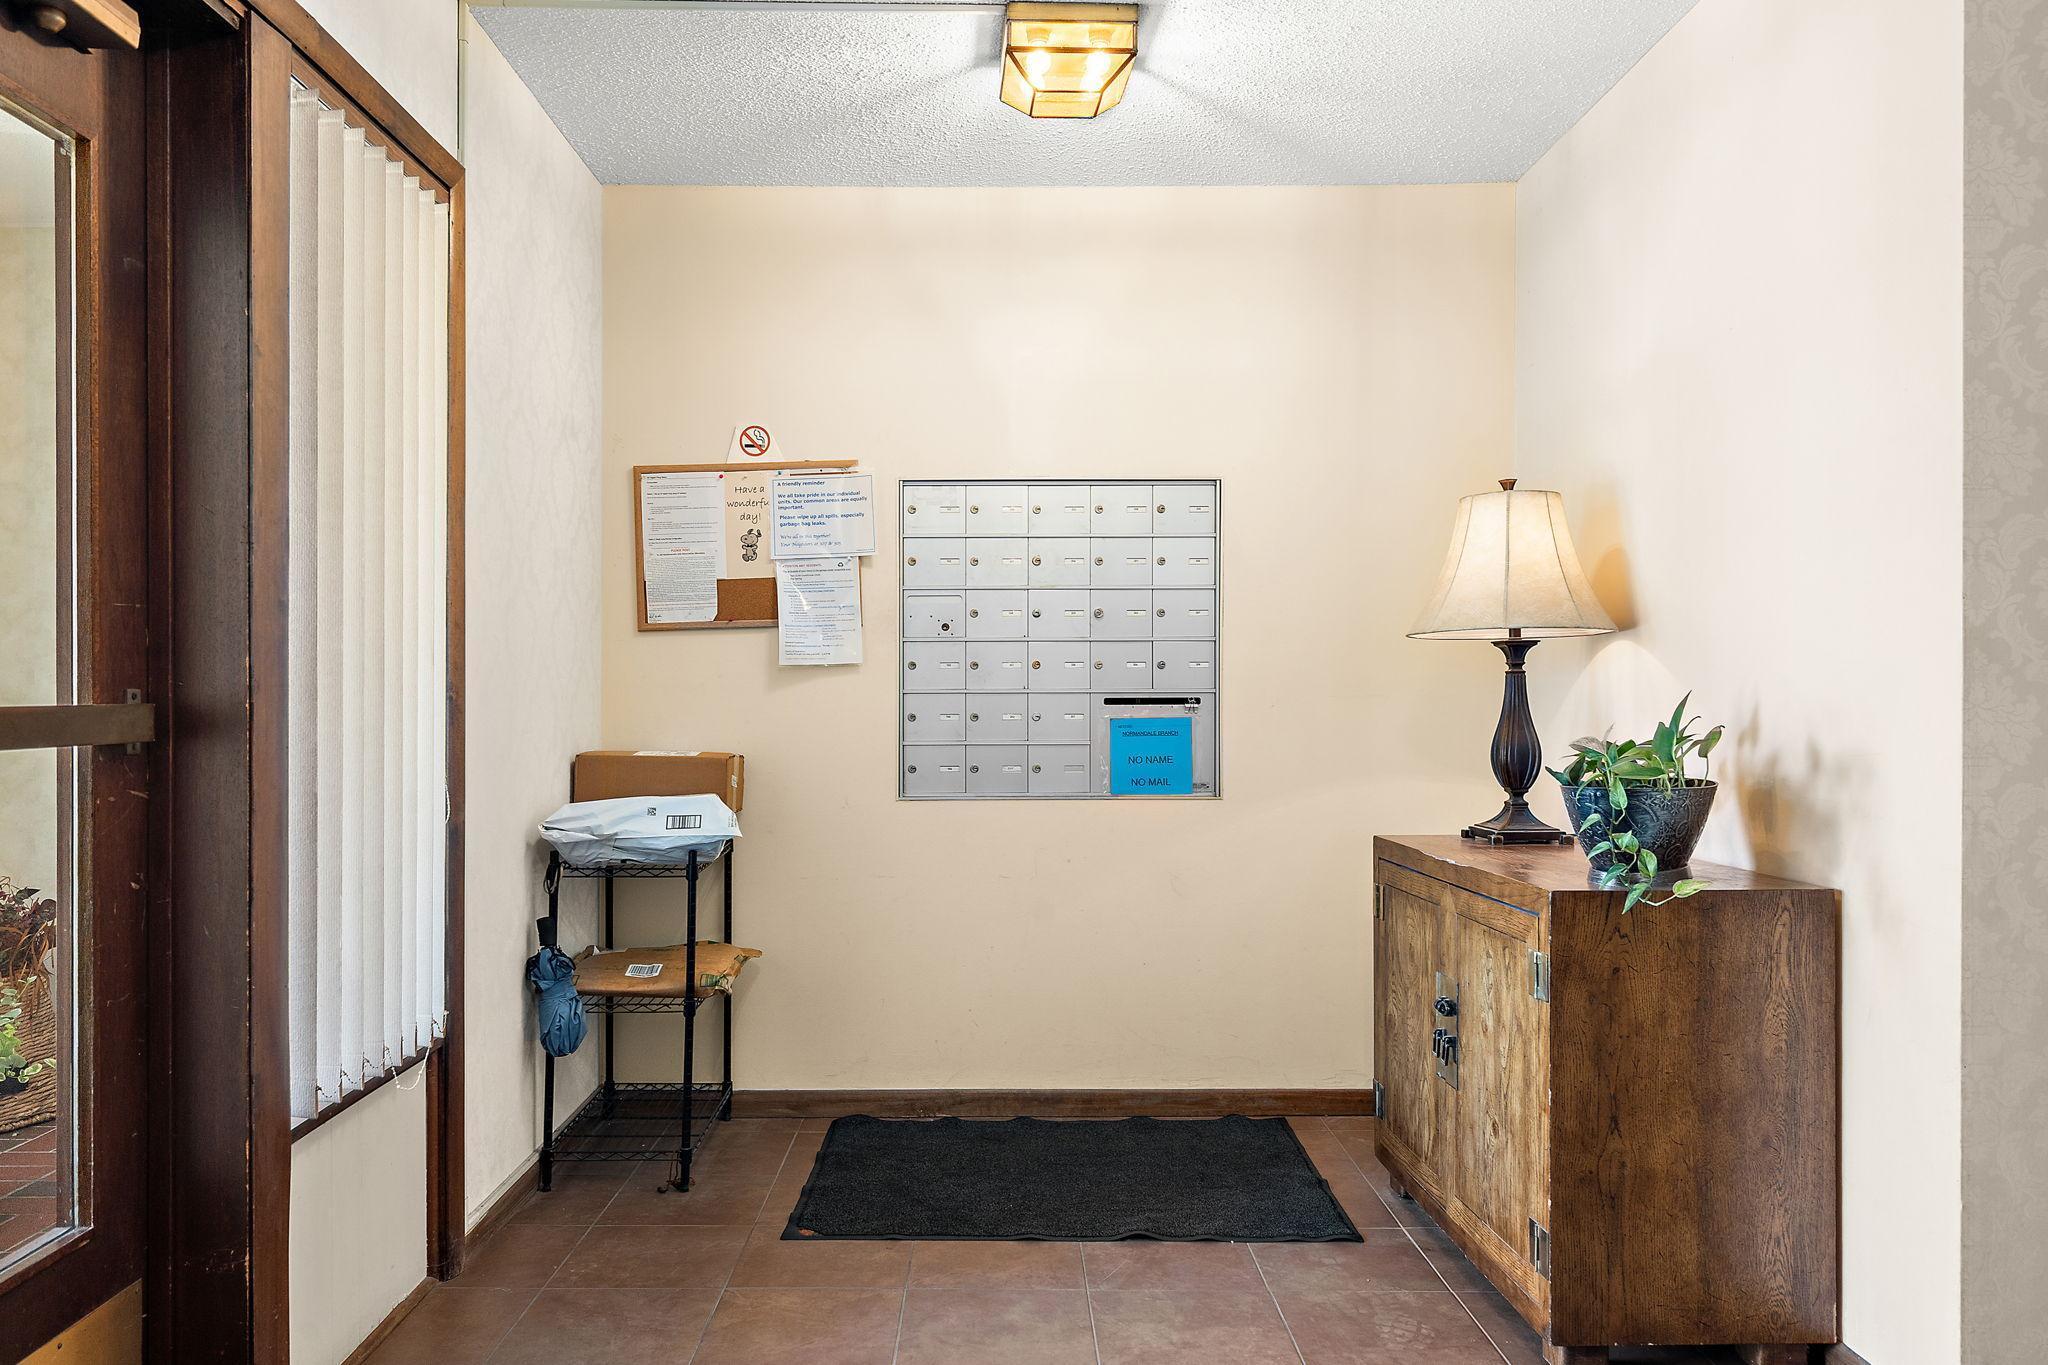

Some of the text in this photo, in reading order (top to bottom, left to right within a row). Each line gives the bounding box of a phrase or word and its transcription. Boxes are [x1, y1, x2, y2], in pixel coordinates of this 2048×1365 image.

[727, 498, 769, 509] wonderfu
[740, 513, 760, 524] day!
[1128, 756, 1173, 764] NO NAME
[1131, 778, 1171, 786] NO MAIL
